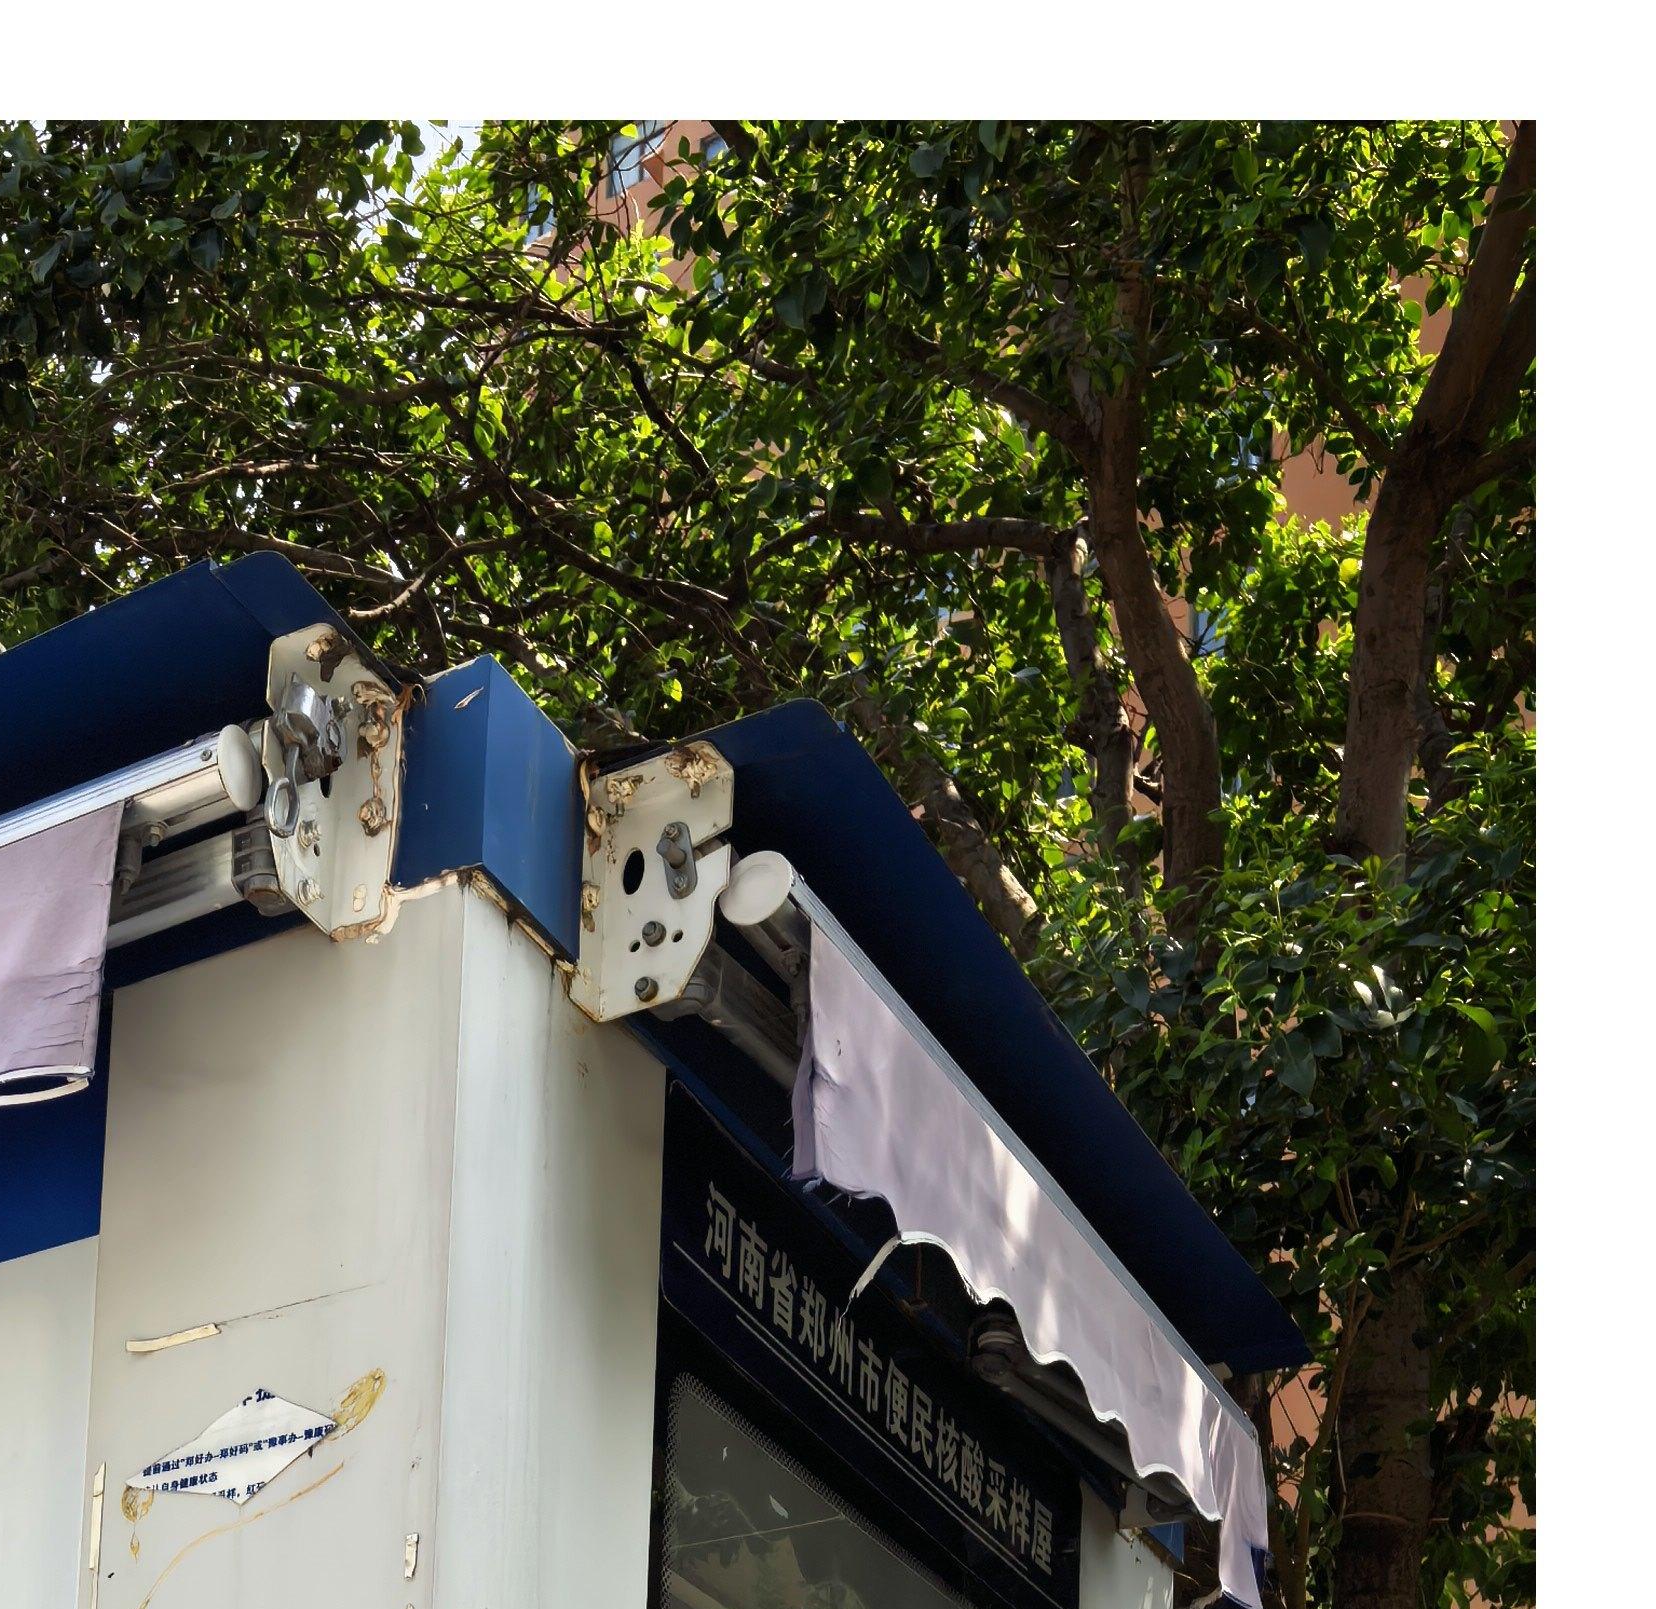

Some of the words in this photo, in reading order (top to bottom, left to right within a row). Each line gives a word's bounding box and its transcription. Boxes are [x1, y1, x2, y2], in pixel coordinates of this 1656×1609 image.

[705, 1181, 1052, 1576] 河南省郑州市便民核酸采样屋
